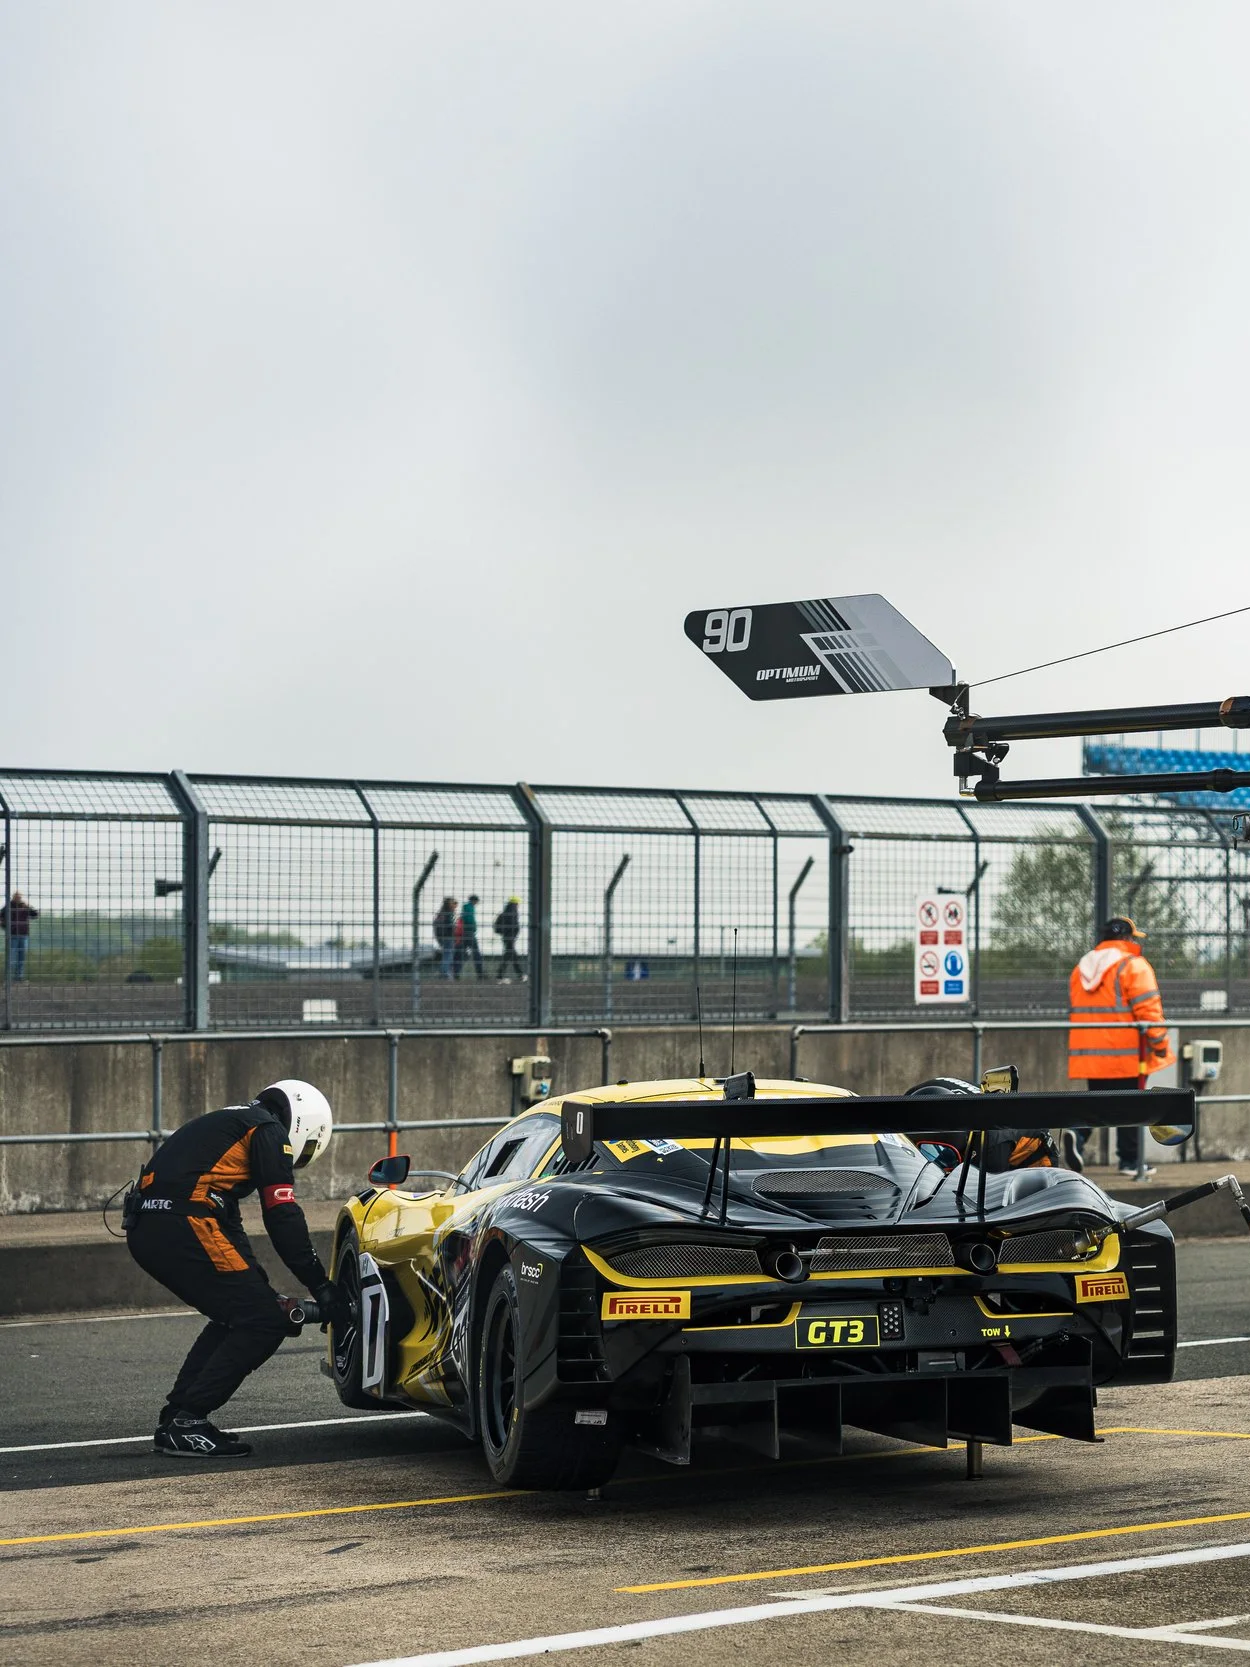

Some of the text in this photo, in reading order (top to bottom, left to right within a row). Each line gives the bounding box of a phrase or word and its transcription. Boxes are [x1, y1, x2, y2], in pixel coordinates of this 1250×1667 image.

[702, 608, 753, 653] 90
[756, 664, 821, 680] OPTIMUM
[141, 1199, 173, 1210] MRTC
[521, 1261, 541, 1279] brscc
[1081, 1277, 1126, 1298] PIRELLI
[609, 1296, 682, 1315] PIRELLI
[808, 1320, 865, 1345] GT3
[981, 1327, 1001, 1337] TOW
